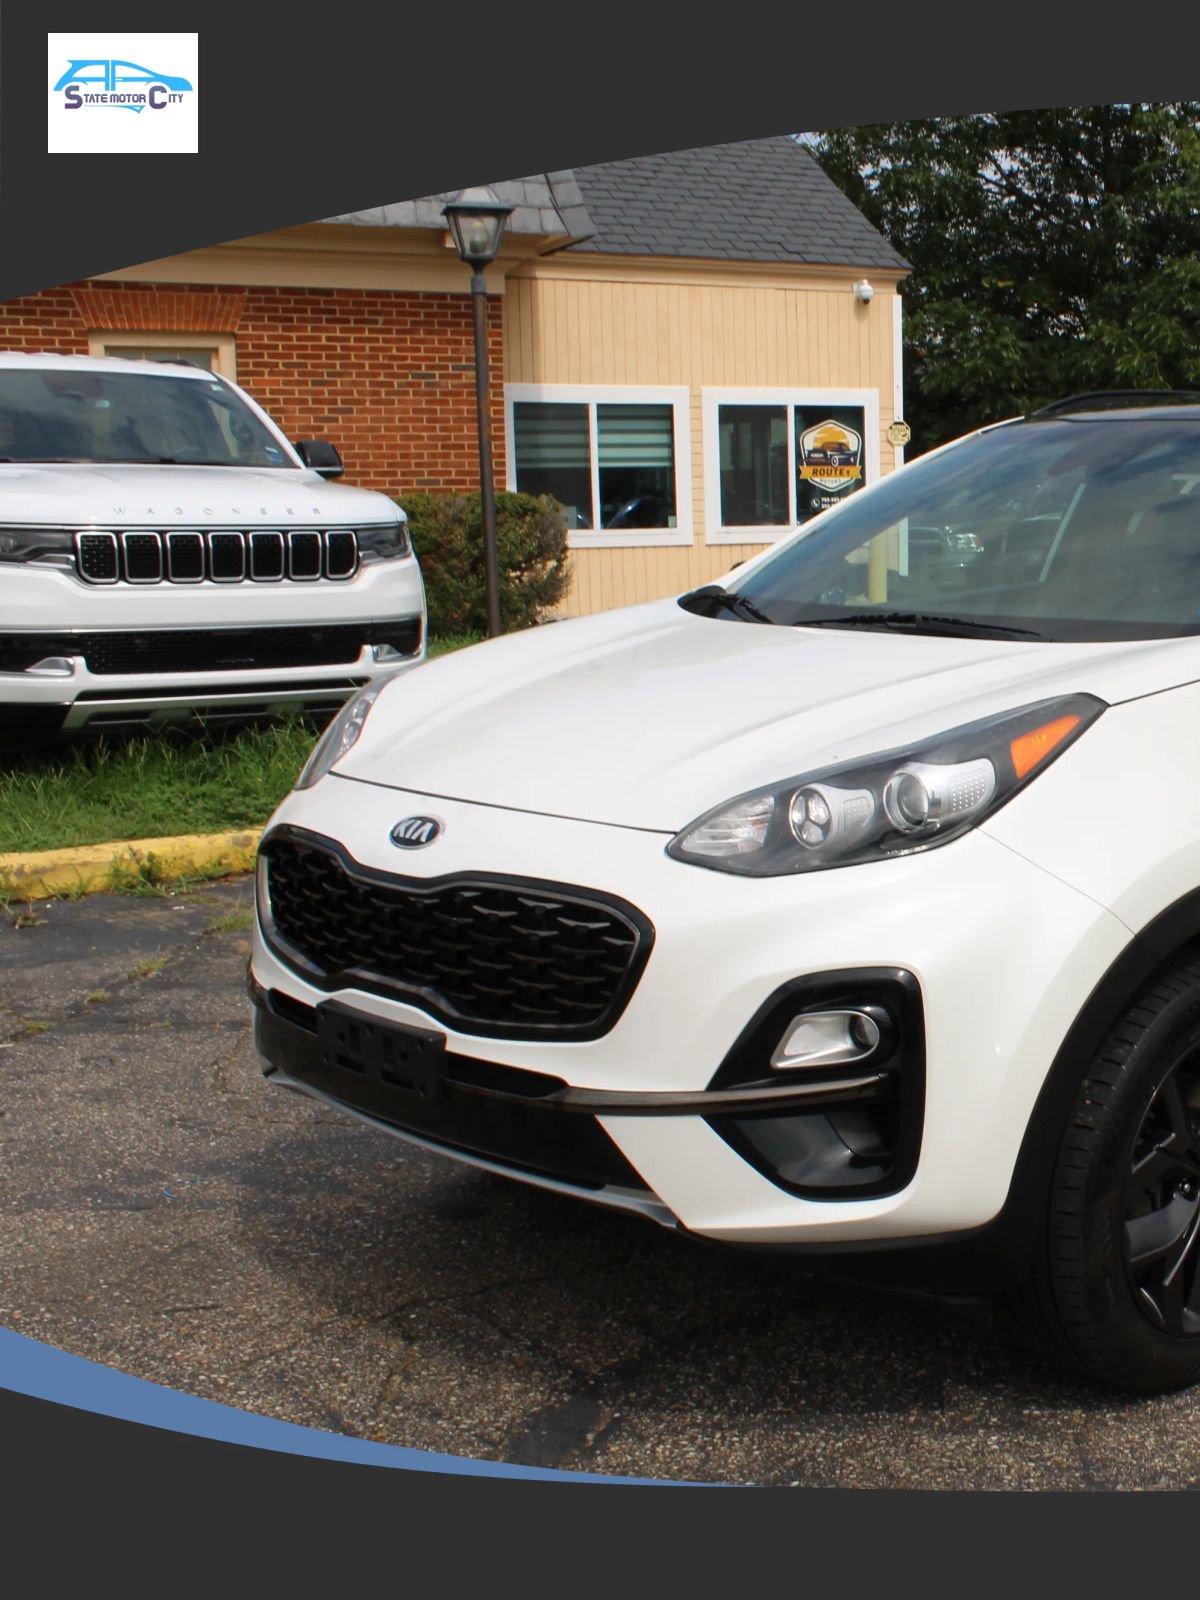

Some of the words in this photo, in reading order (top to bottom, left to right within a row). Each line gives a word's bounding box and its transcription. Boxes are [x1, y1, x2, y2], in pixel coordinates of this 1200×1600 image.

[812, 467, 845, 477] ROUTE
[113, 507, 320, 515] WAGONEER
[393, 819, 434, 843] KIA
